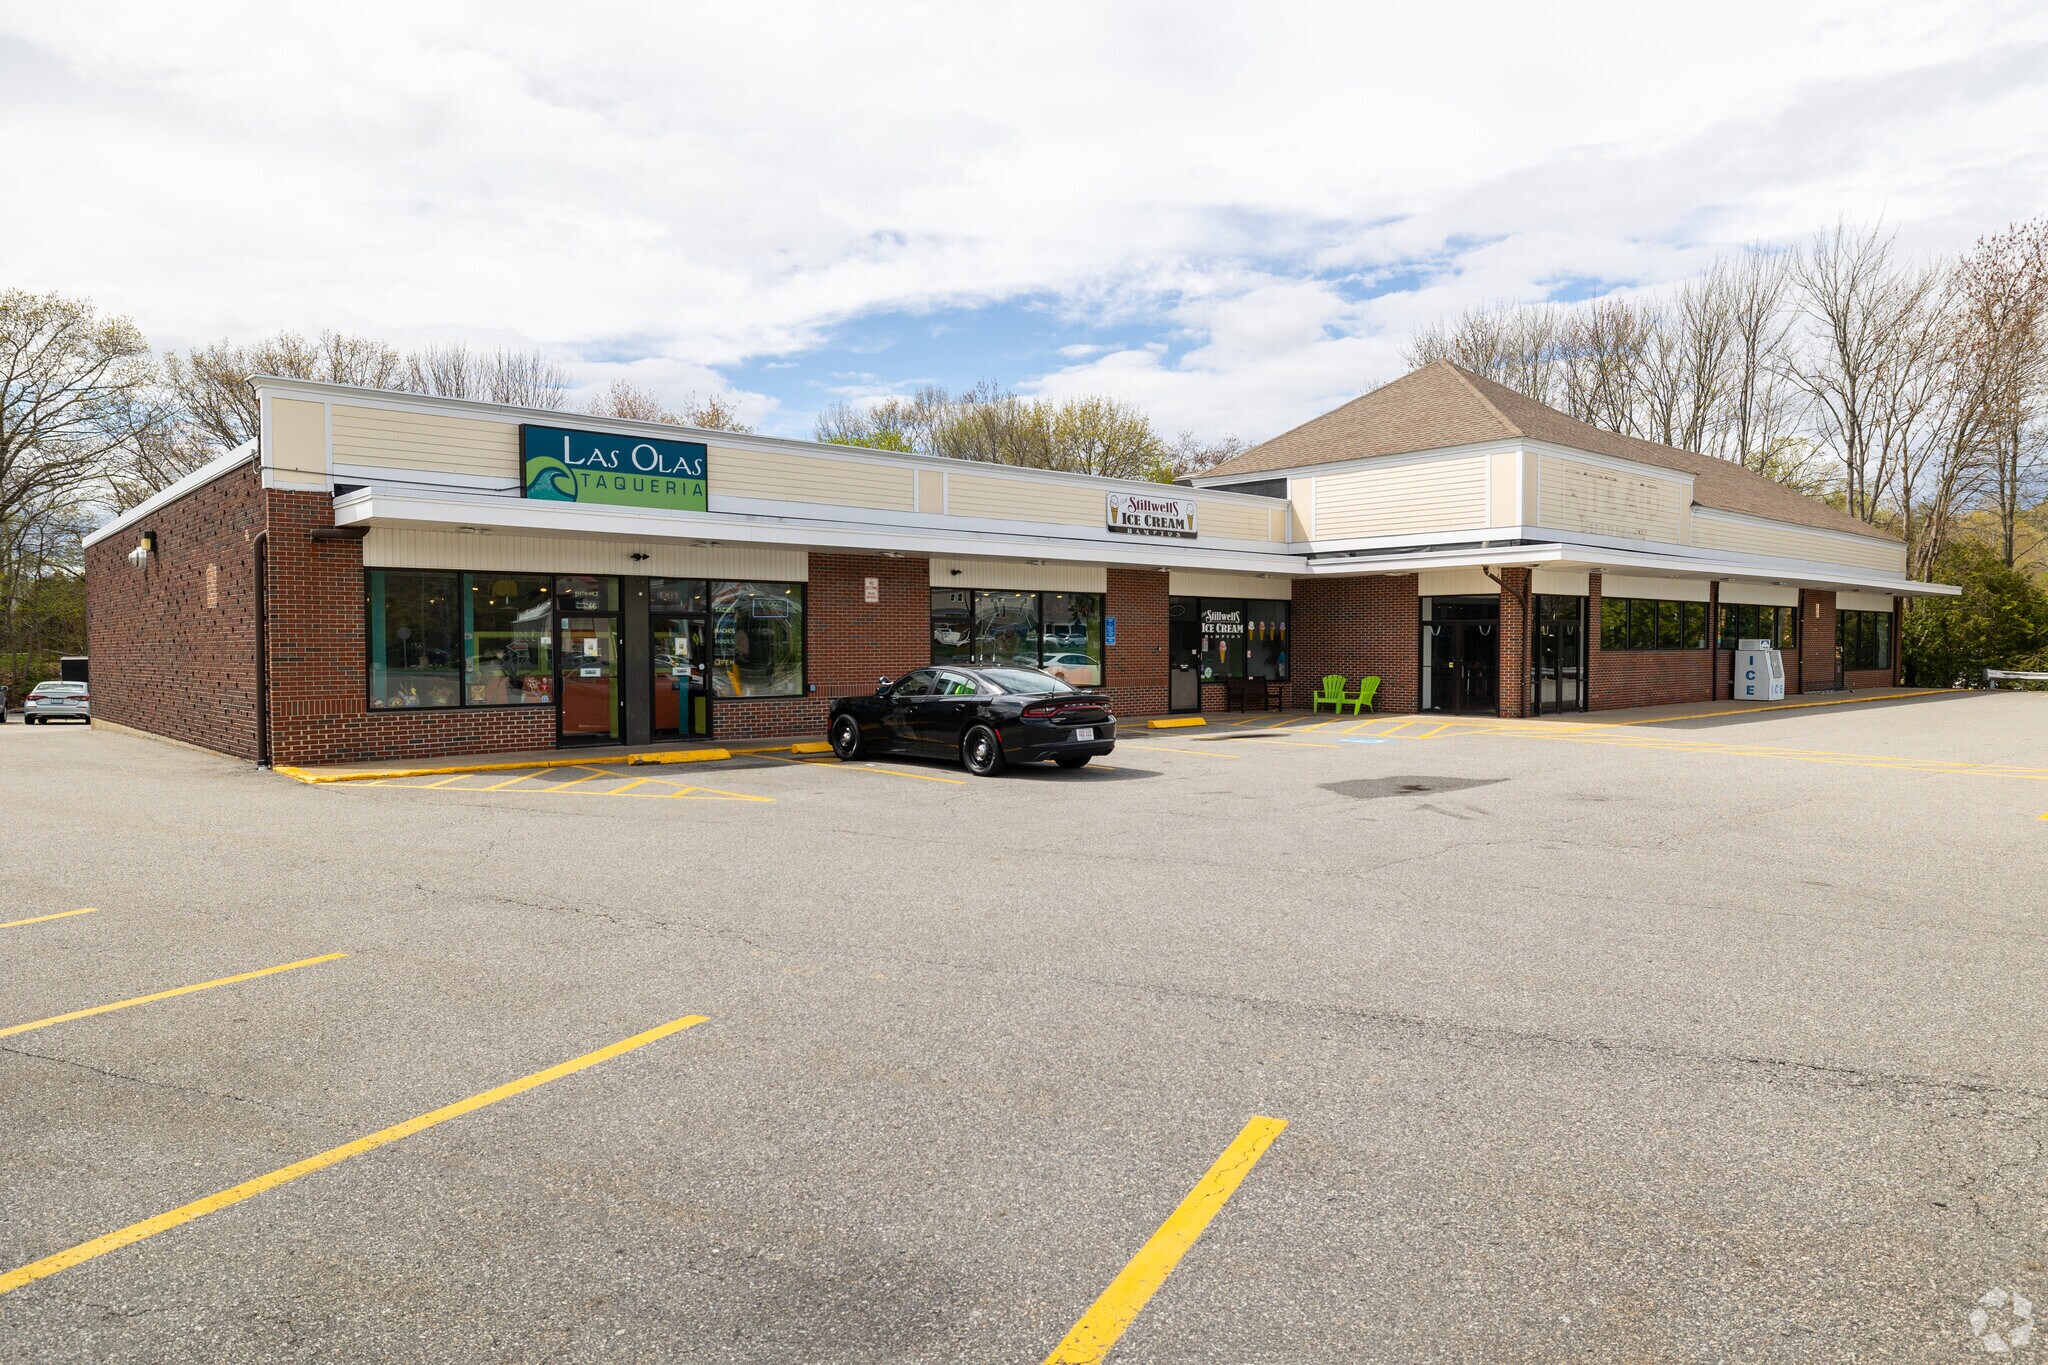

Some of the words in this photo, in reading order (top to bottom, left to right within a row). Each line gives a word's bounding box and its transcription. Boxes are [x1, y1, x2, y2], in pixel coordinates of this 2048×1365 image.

[563, 436, 619, 468] LAS
[631, 444, 703, 476] OLAS
[580, 473, 703, 497] TAQUERIA
[1121, 512, 1141, 526] ICE
[1144, 514, 1185, 530] CREAM
[1126, 528, 1182, 538] HAMPTON
[1201, 622, 1215, 633] ICE
[1215, 623, 1244, 633] CREAM
[1745, 655, 1755, 695] ICE
[1771, 684, 1784, 695] ICE
